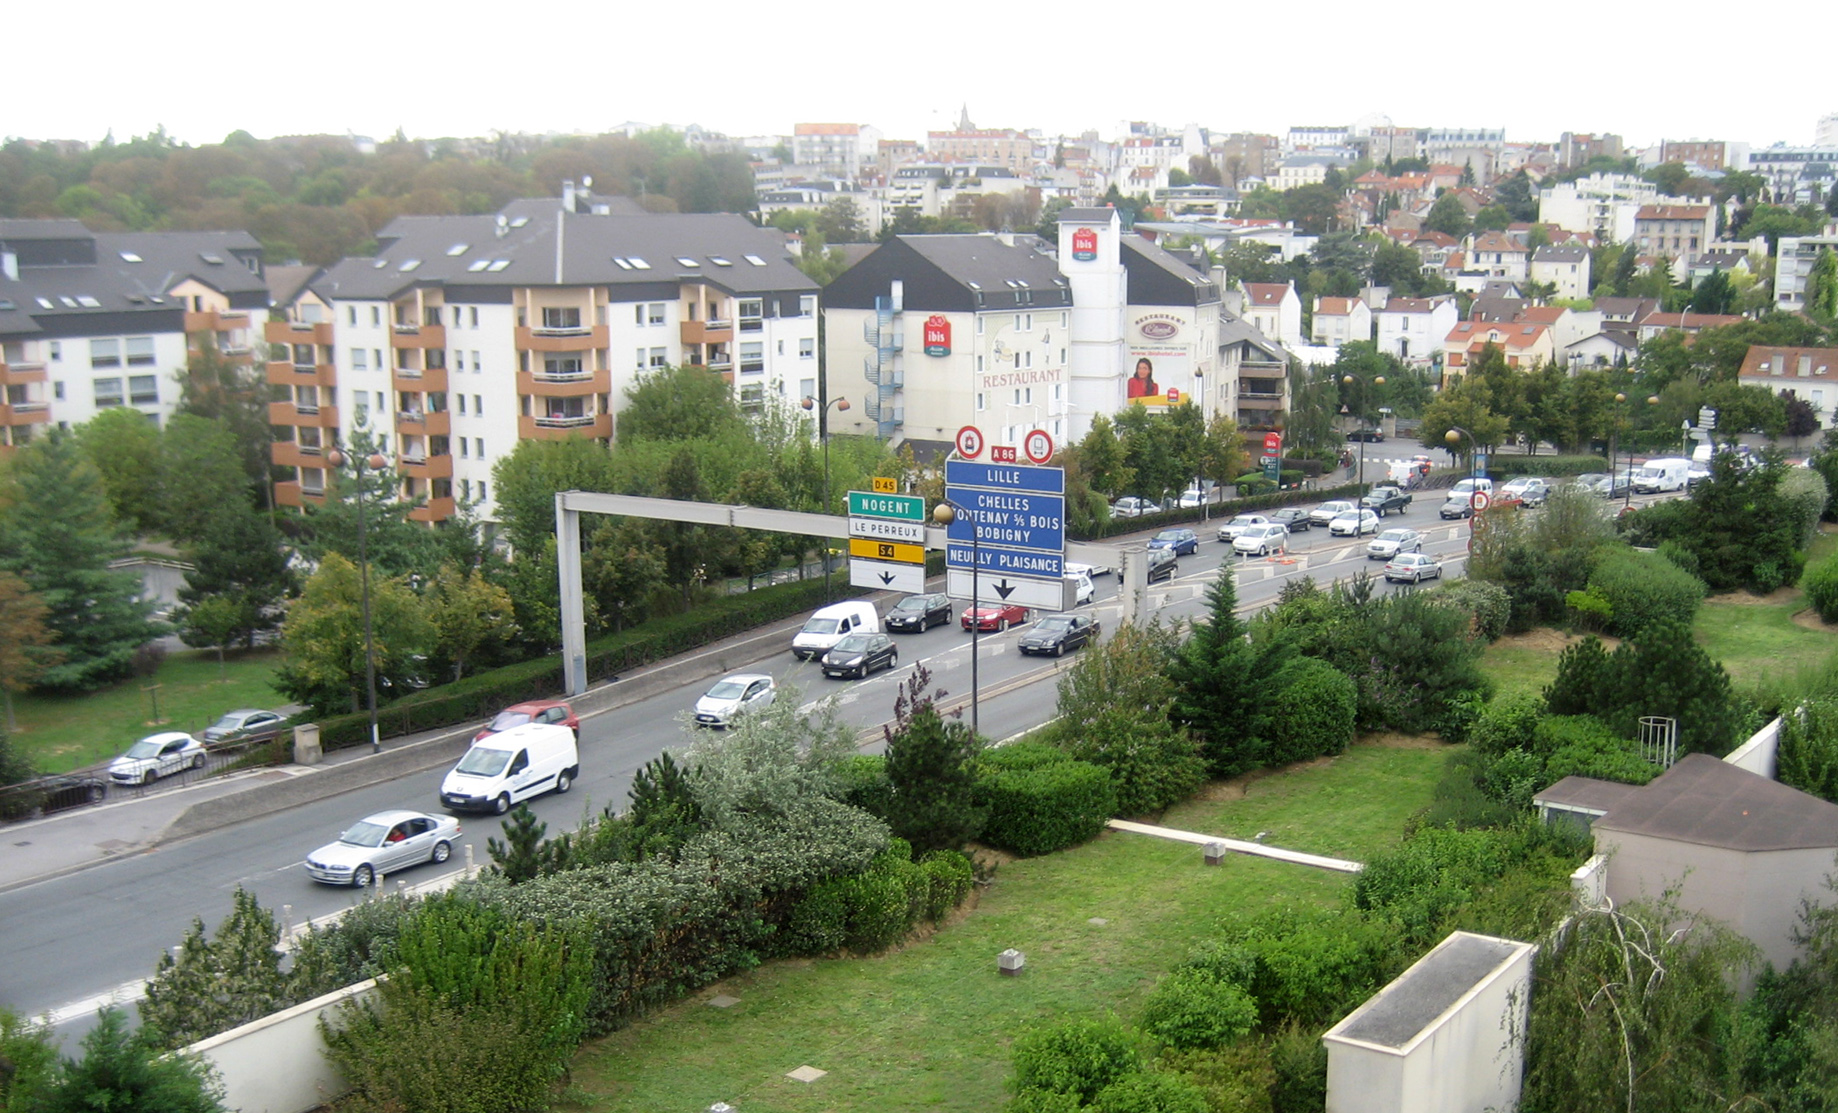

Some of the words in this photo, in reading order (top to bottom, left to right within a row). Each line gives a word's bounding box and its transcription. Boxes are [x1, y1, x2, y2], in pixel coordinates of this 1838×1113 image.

[1076, 239, 1092, 249] ibis
[928, 330, 945, 342] ibis
[983, 368, 1061, 388] RESTAURANT
[993, 448, 1000, 459] A
[1002, 449, 1015, 460] 86
[987, 469, 1020, 484] LILLE
[874, 480, 881, 489] D
[882, 481, 895, 491] 45
[861, 498, 910, 514] NOGENT
[977, 494, 1030, 512] CHELLES
[855, 522, 866, 532] LE
[871, 523, 918, 538] PERREUX
[1029, 515, 1060, 530] BOIS
[976, 525, 1031, 543] BOBIGNY
[950, 549, 992, 565] NEUILY
[999, 554, 1059, 573] PLAISANCE
